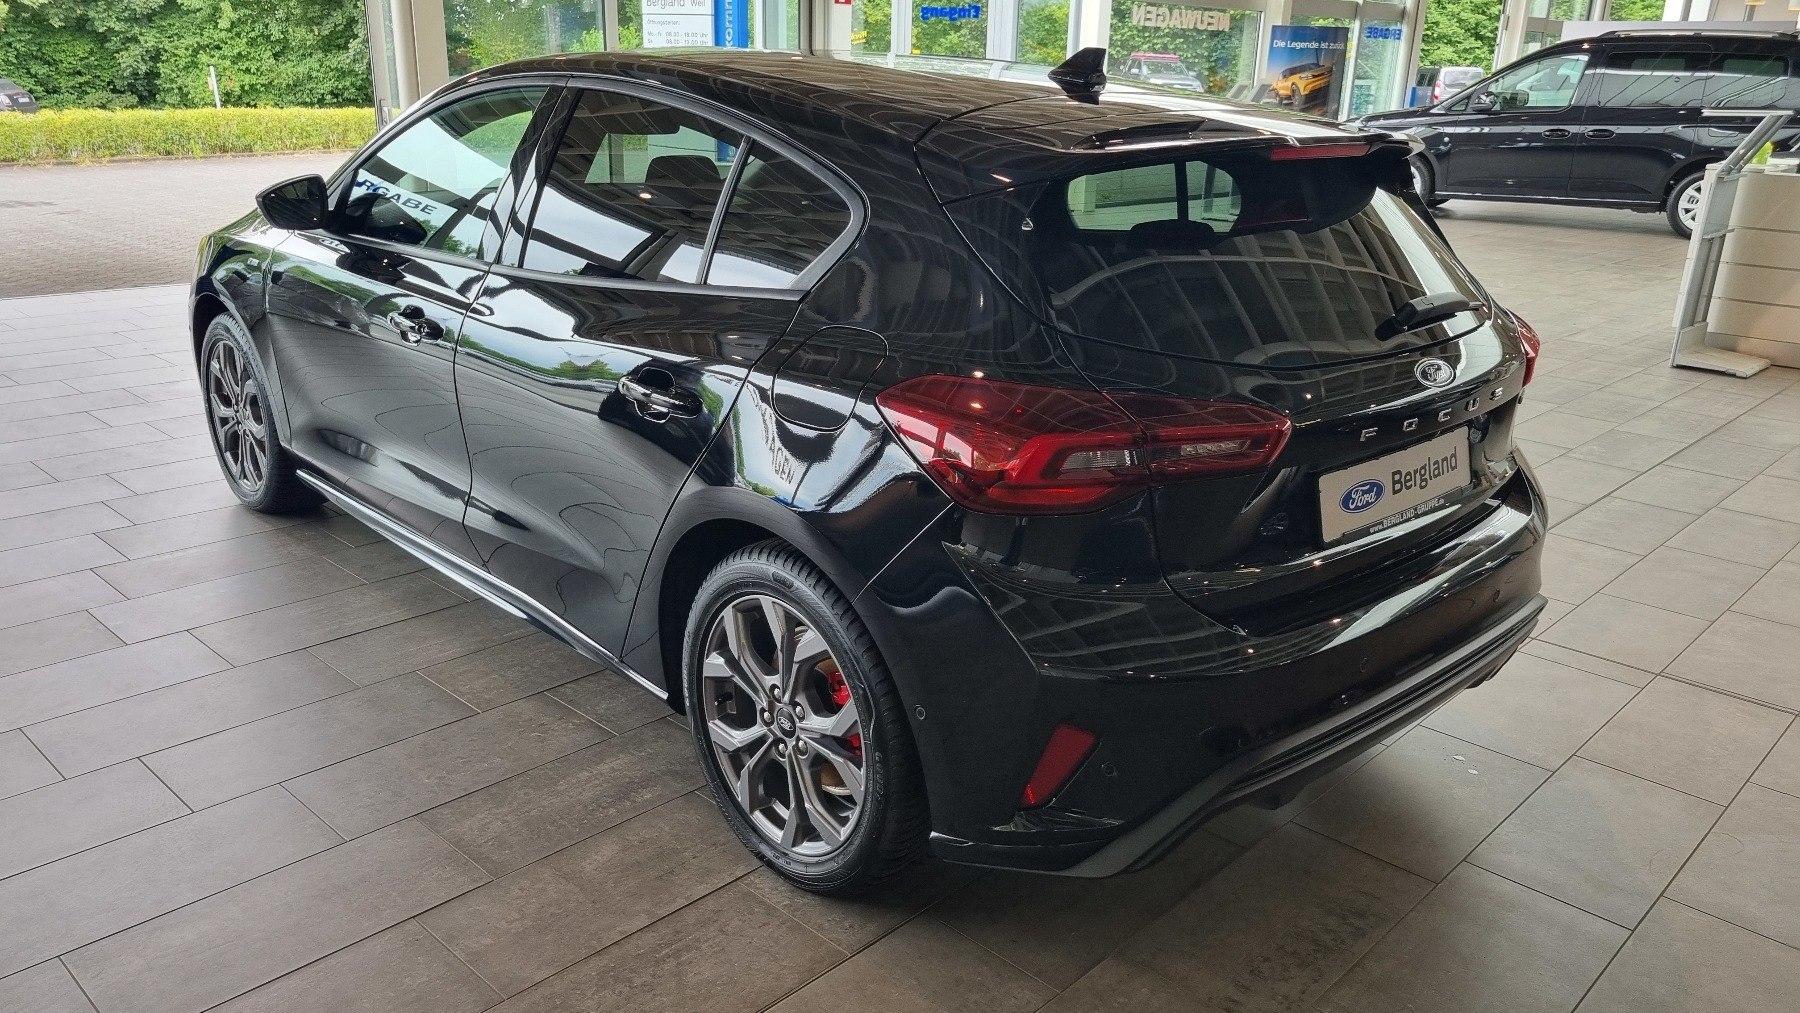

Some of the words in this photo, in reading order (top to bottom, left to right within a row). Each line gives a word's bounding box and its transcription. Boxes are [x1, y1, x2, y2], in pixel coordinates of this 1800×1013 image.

[1273, 39, 1286, 48] Die
[1287, 40, 1319, 49] Legende
[1320, 40, 1329, 49] ist
[1360, 387, 1504, 442] FOCUS
[1391, 445, 1458, 496] Bergland
[1348, 484, 1379, 509] Ford
